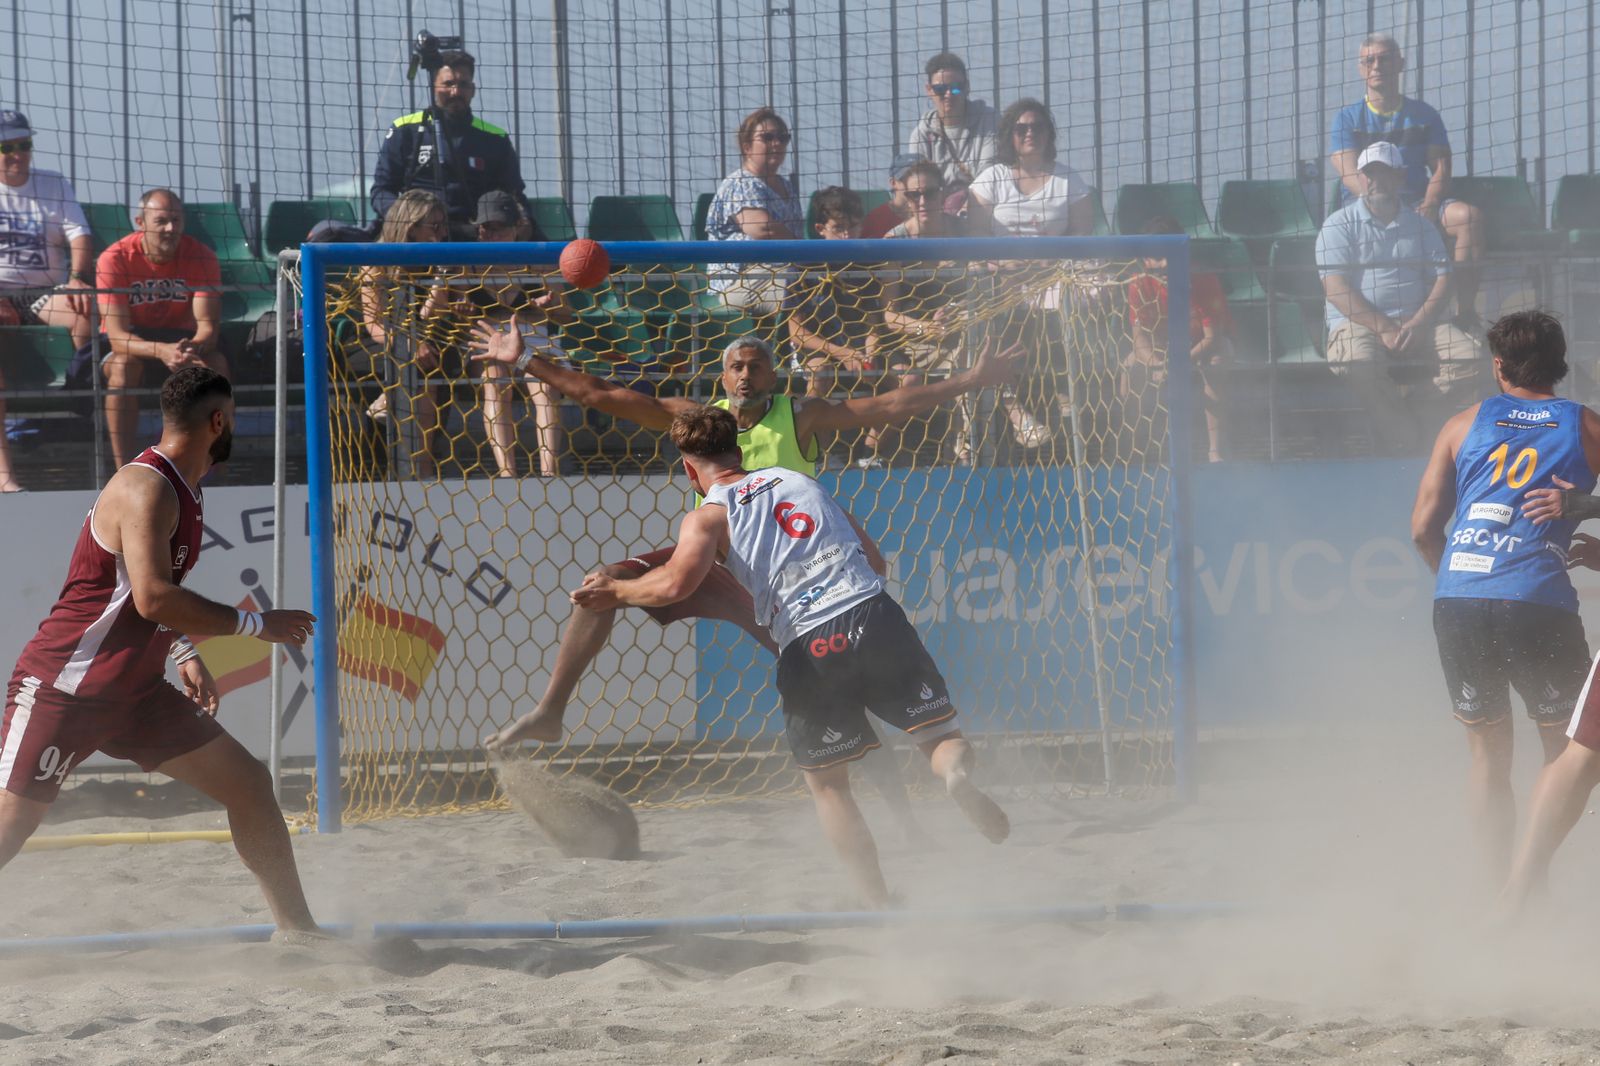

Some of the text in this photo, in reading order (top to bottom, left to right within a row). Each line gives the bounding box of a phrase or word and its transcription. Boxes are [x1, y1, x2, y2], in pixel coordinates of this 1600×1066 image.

[1508, 409, 1551, 421] Joma
[1487, 442, 1538, 489] 10
[773, 501, 816, 539] 6
[34, 745, 76, 785] 94
